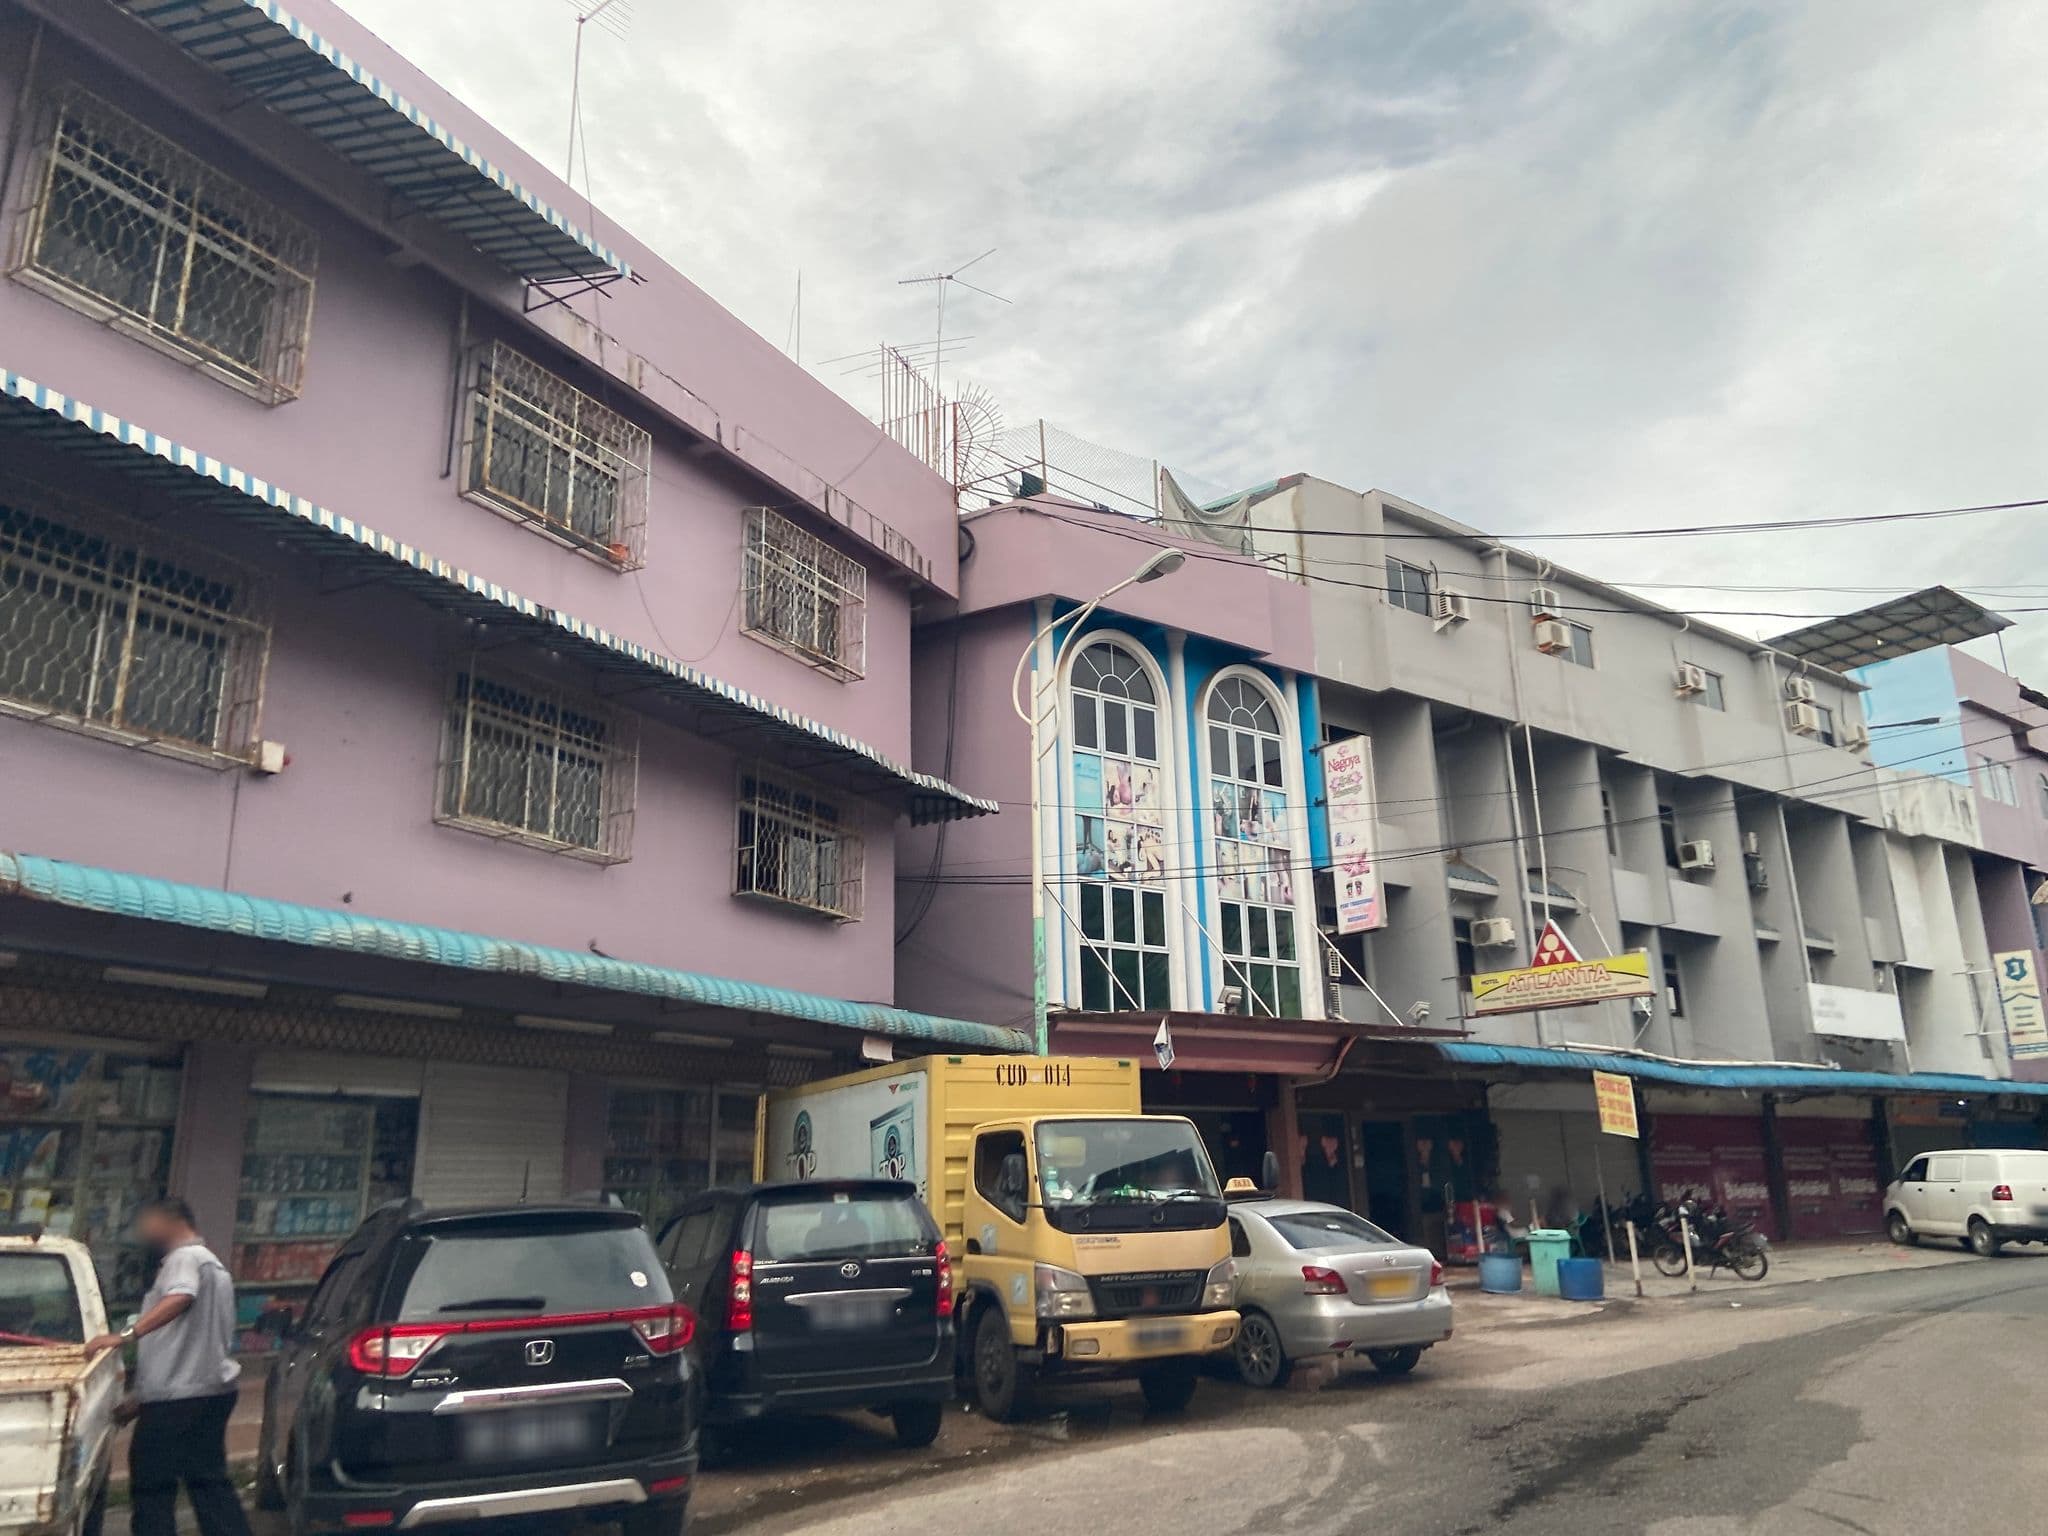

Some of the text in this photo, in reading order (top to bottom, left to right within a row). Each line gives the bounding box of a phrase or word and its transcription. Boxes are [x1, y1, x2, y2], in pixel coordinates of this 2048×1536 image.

[1328, 754, 1361, 773] Nagoya
[1506, 962, 1612, 993] ATLANTA
[996, 1063, 1071, 1086] CUD 014
[879, 1153, 907, 1180] TOP
